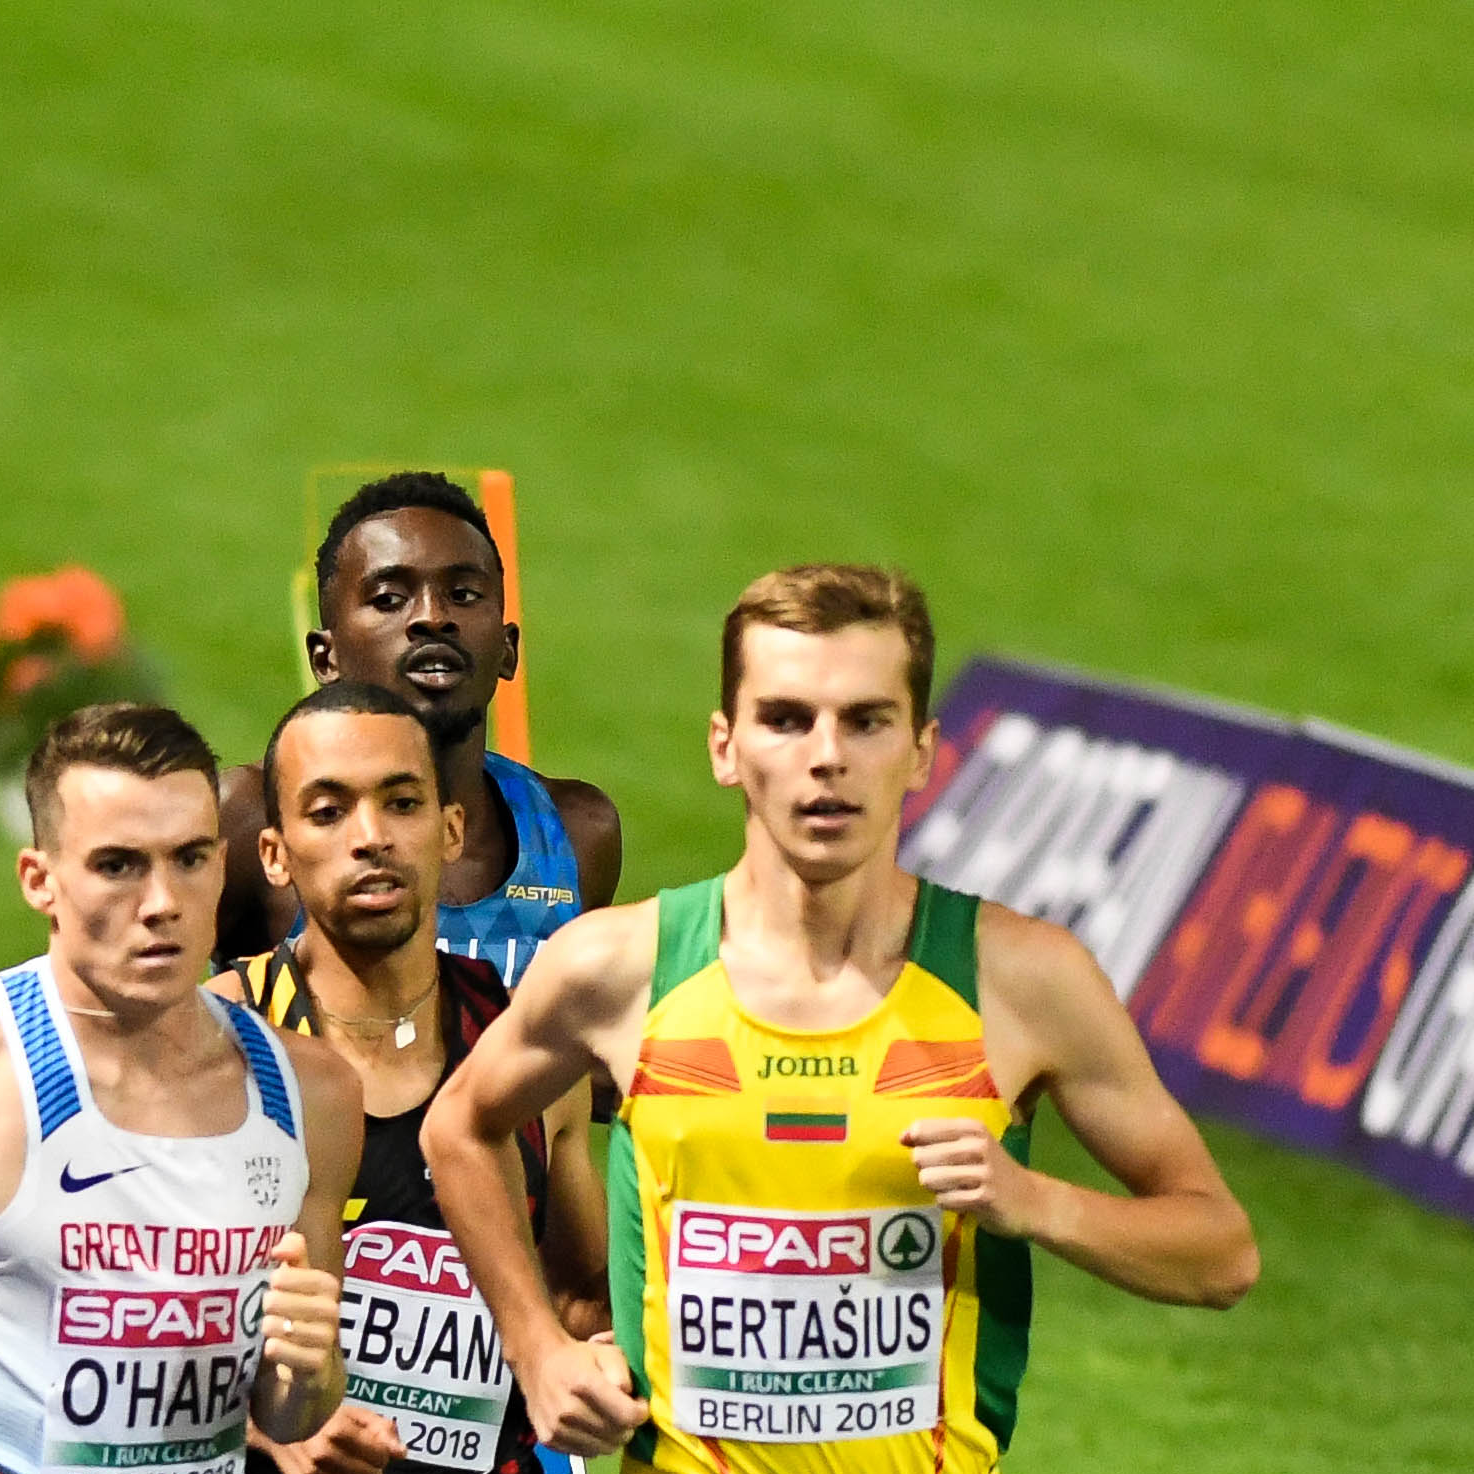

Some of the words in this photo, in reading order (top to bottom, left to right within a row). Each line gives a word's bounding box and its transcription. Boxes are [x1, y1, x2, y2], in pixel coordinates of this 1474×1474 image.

[60, 1223, 169, 1271] GREAT
[344, 1233, 470, 1290] PAR
[683, 1217, 866, 1268] SPAR
[63, 1296, 232, 1340] SPAR
[340, 1291, 502, 1386] EBJANI
[681, 1284, 931, 1359] BERTAŠIUS
[347, 1379, 377, 1400] UN
[728, 1373, 736, 1390] I
[742, 1372, 791, 1393] RUN
[699, 1398, 821, 1434] BERLIN
[837, 1397, 915, 1432] 2018
[116, 1446, 156, 1464] RUN
[408, 1421, 481, 1461] 2018
